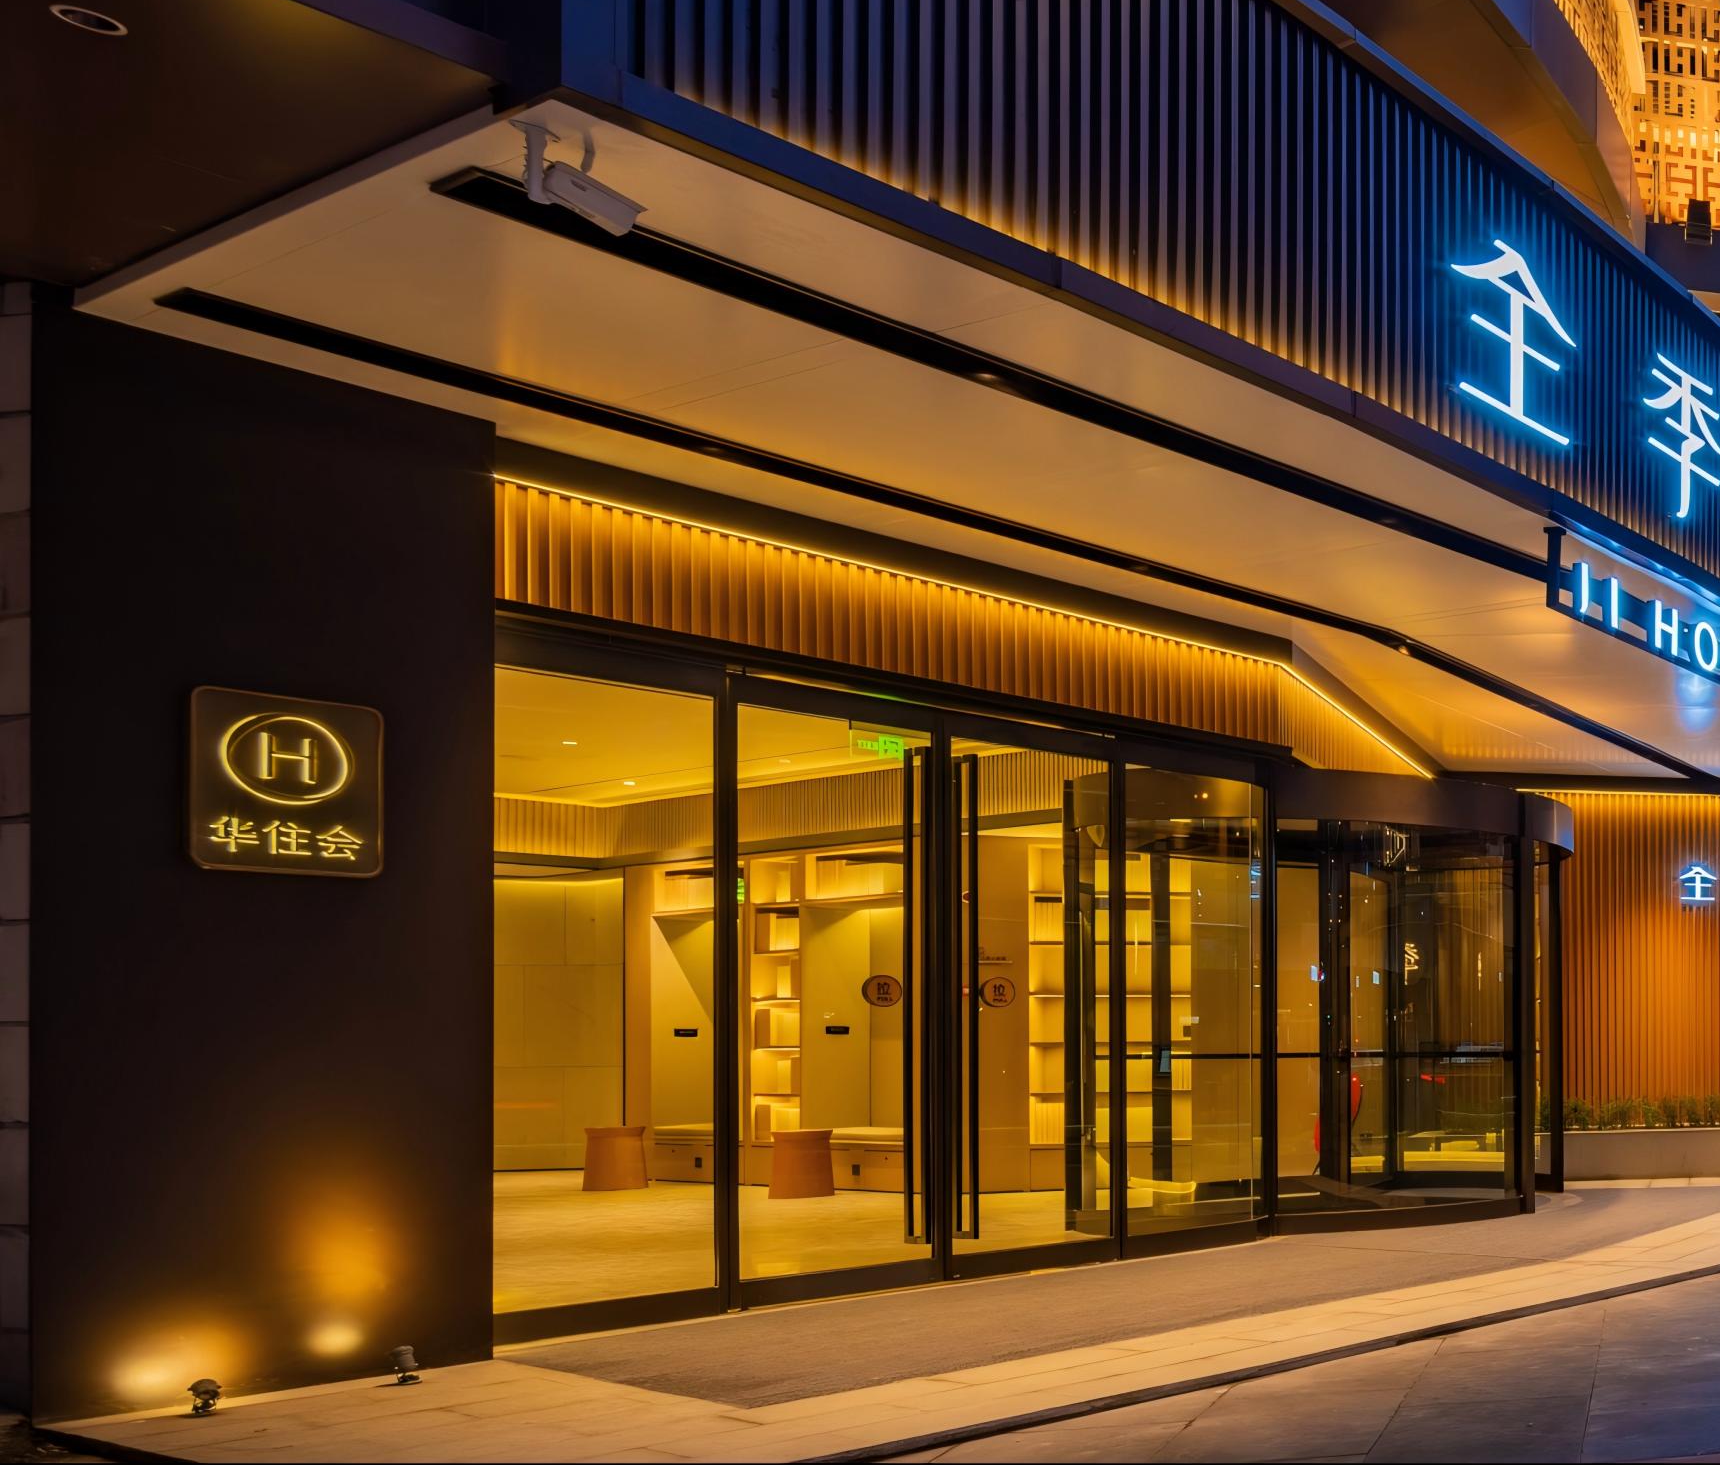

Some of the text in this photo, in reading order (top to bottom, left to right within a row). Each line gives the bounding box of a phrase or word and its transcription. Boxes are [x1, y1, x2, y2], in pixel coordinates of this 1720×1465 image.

[1579, 561, 1620, 630] JI
[208, 815, 364, 861] 华住会
